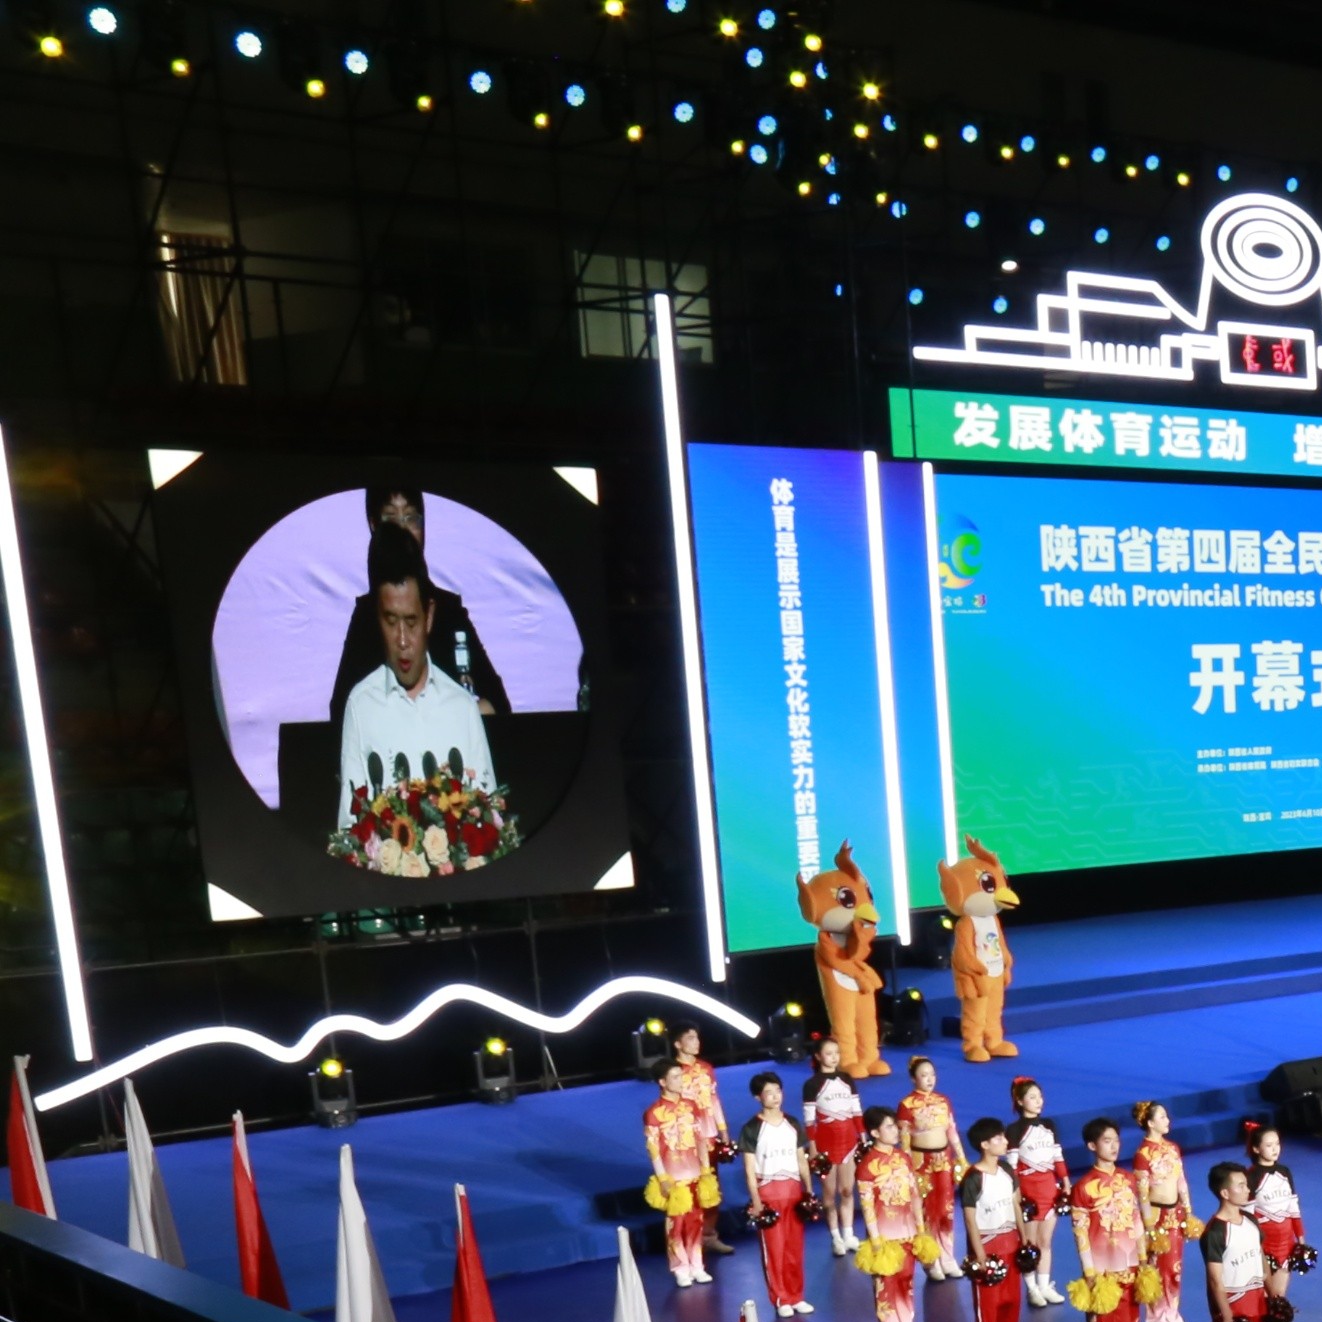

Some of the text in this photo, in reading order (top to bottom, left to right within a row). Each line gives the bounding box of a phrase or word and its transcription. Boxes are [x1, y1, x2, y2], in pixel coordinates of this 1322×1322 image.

[953, 401, 1247, 462] 发展体育运动
[1040, 583, 1084, 607] The
[1088, 583, 1127, 607] 4th
[1132, 584, 1241, 608] Provincial
[1245, 585, 1316, 608] Fitness
